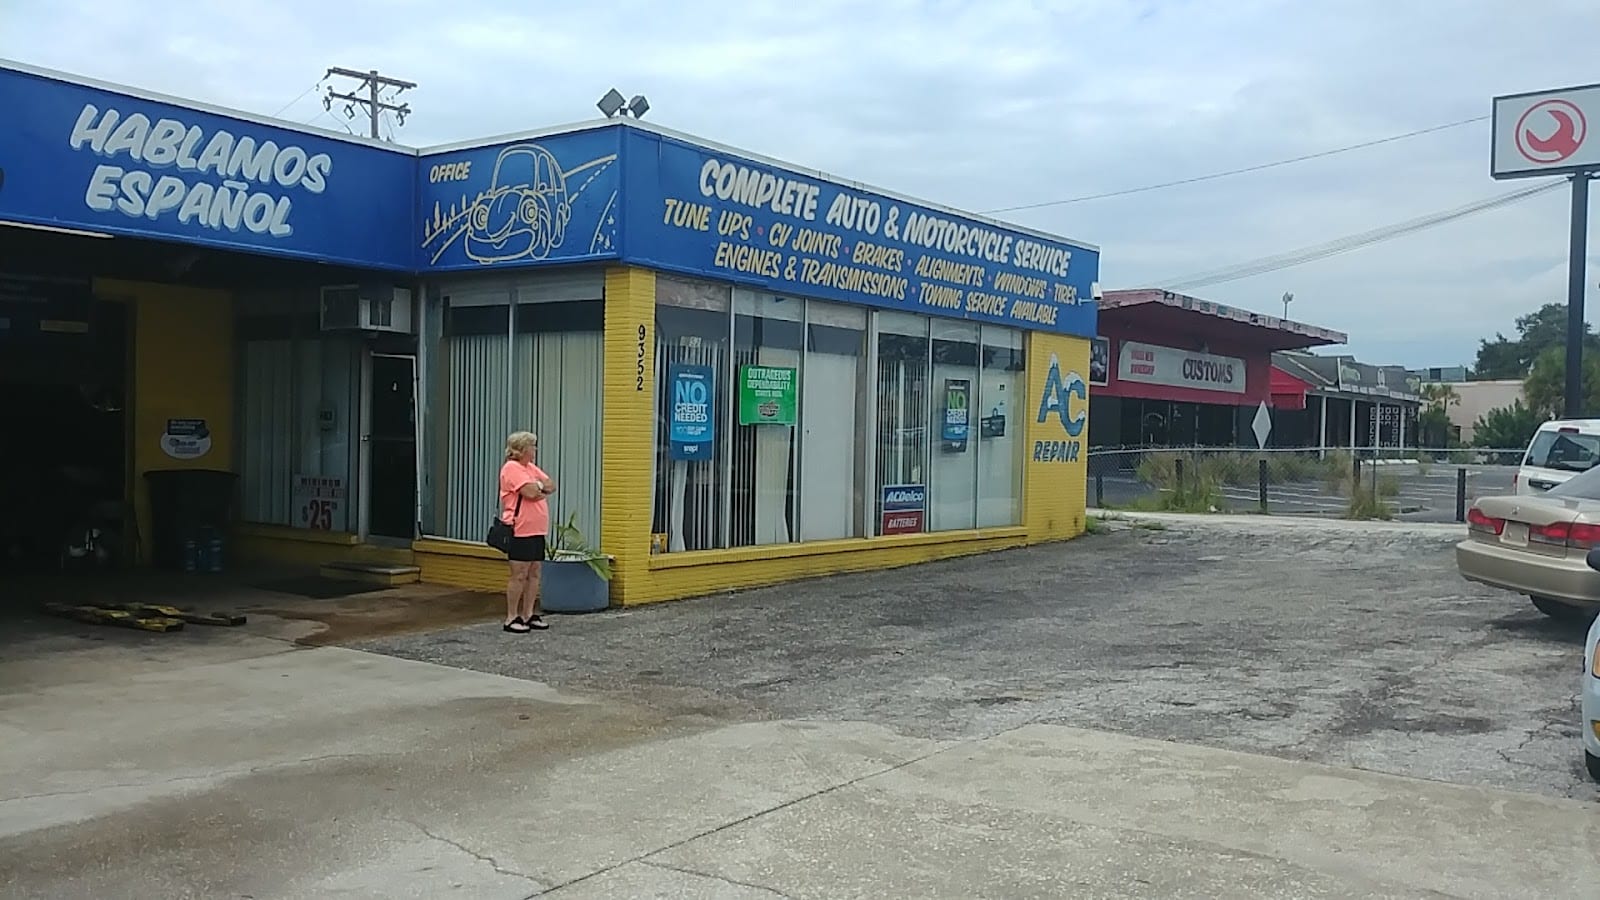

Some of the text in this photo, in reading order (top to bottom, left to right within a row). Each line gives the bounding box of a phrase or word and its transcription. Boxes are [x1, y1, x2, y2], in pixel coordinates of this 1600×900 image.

[70, 104, 332, 193] HABLAMOS
[429, 161, 472, 184] OFFICE
[85, 165, 293, 237] ESPAÑOL
[699, 159, 1072, 277] COMPLETE AUTO & MOTORCYCLE SERVICE
[663, 199, 1077, 306] TUNE UPS CV JOINTS BRAKES ALIGNMENTS WINDOWS TIRES
[714, 242, 1059, 326] ENGINES & TRANSMISSIONS TOWING SERVICE AVAILABLE
[637, 324, 646, 391] 9352
[748, 368, 791, 380] OUTRAGEOUS
[1183, 358, 1233, 384] CUSTOMS
[675, 380, 706, 404] NO
[947, 391, 967, 410] NO
[1037, 351, 1087, 437] AC
[674, 403, 708, 413] CREDIT
[674, 412, 708, 422] NEEDED
[1033, 440, 1080, 462] REPAIR
[886, 490, 924, 503] ACDelco
[888, 518, 918, 529] BATTERIES
